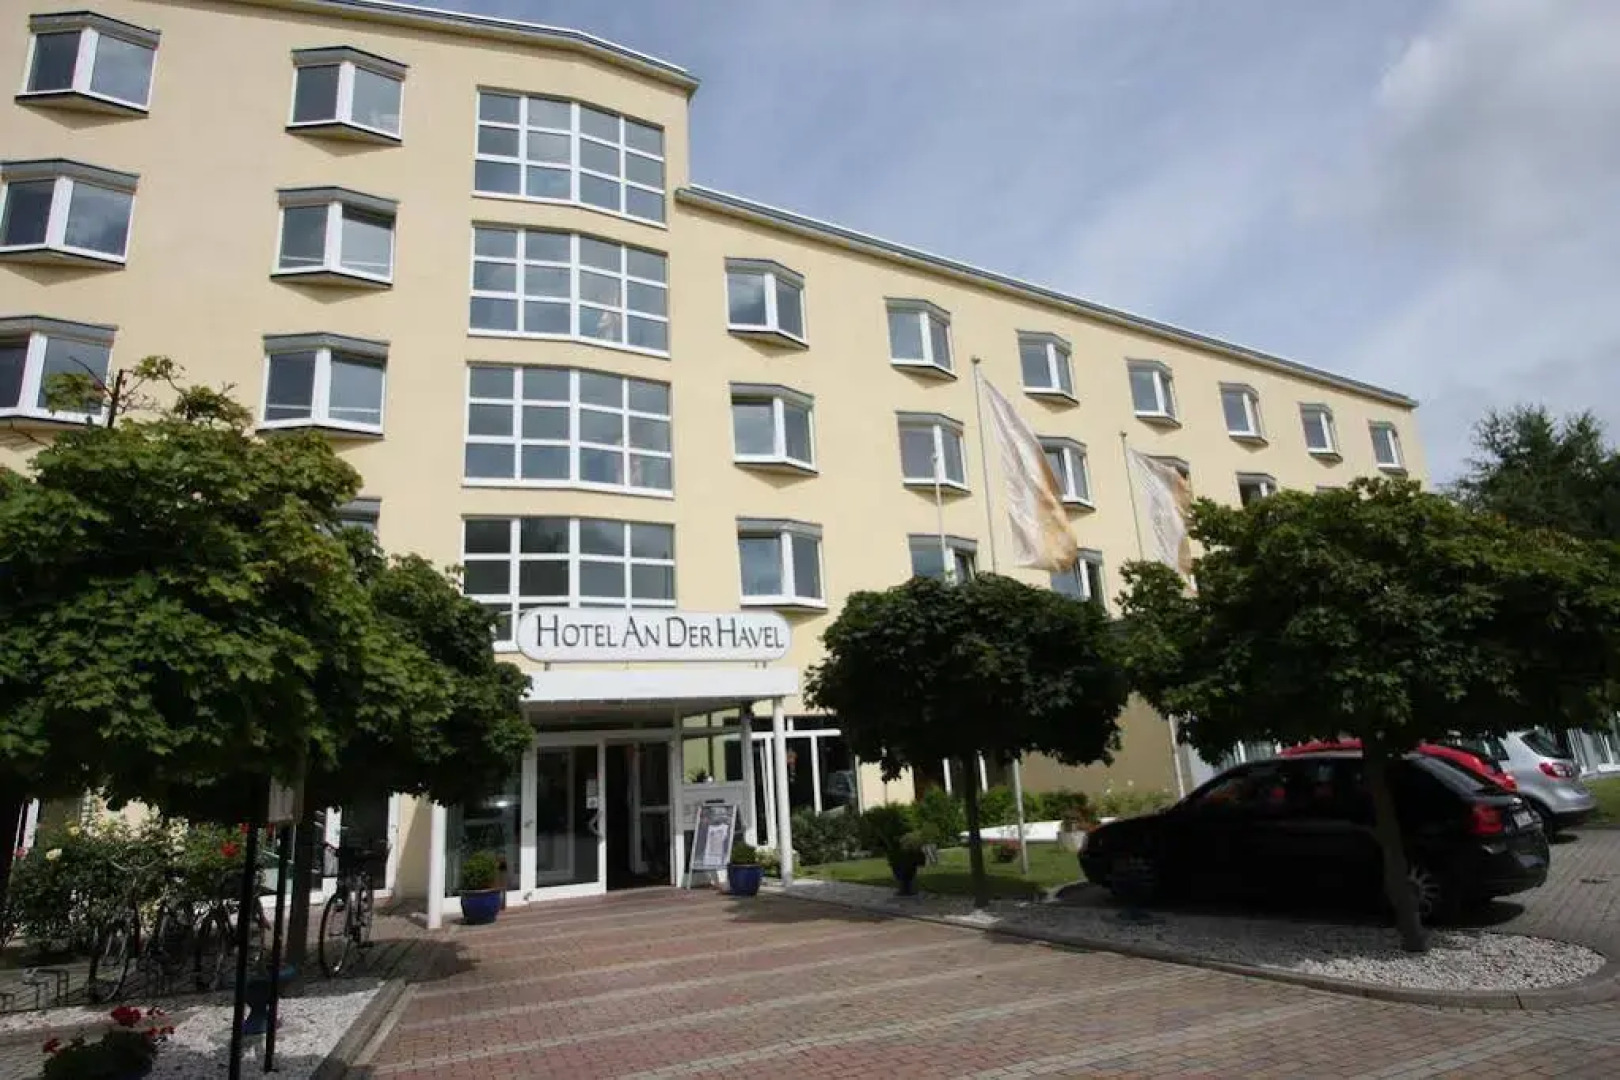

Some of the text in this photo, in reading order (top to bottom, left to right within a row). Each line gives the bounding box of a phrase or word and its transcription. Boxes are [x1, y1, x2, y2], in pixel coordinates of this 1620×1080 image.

[536, 613, 785, 649] HOTEL AN DER HAVEL
